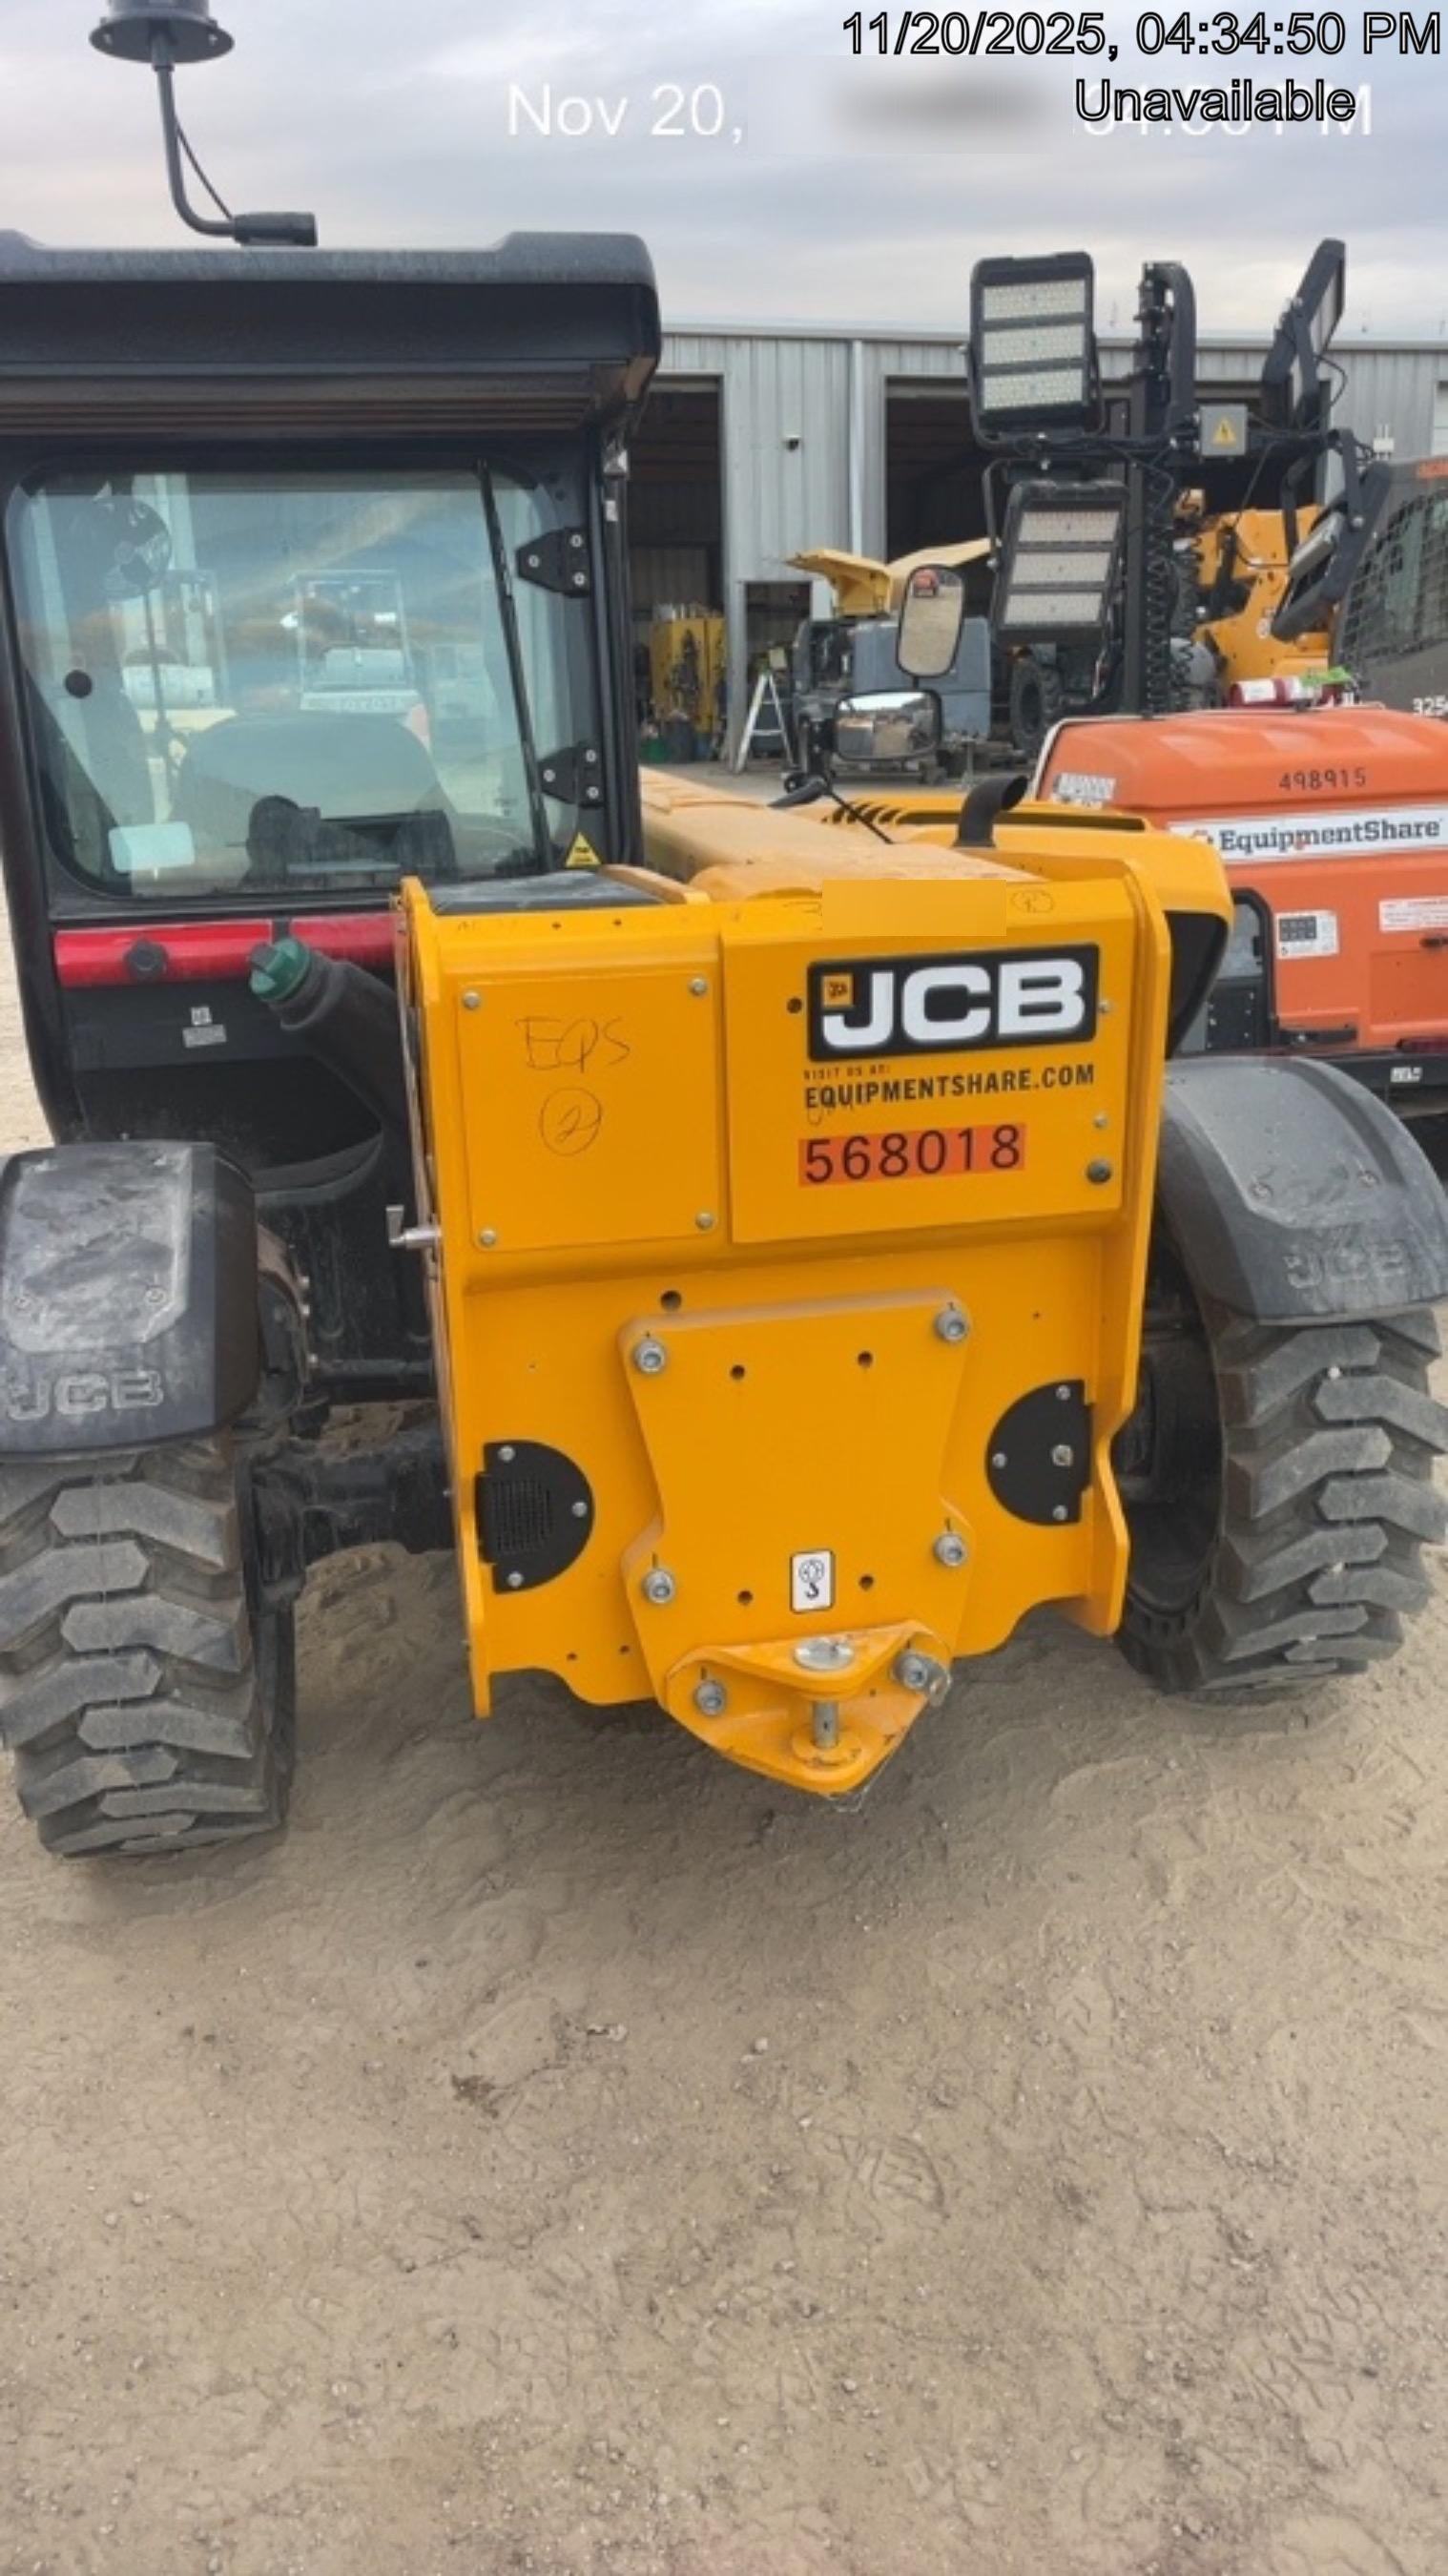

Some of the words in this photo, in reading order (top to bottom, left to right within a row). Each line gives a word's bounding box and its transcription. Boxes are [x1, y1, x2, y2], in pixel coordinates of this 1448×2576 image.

[1279, 767, 1367, 791] 498915
[1219, 818, 1441, 854] EquipmentShare
[821, 958, 1086, 1049] JCB
[804, 1064, 1095, 1109] EQUIPMENTSHARE.COM
[805, 1124, 1021, 1183] 568018
[8, 1370, 164, 1421] JCB
